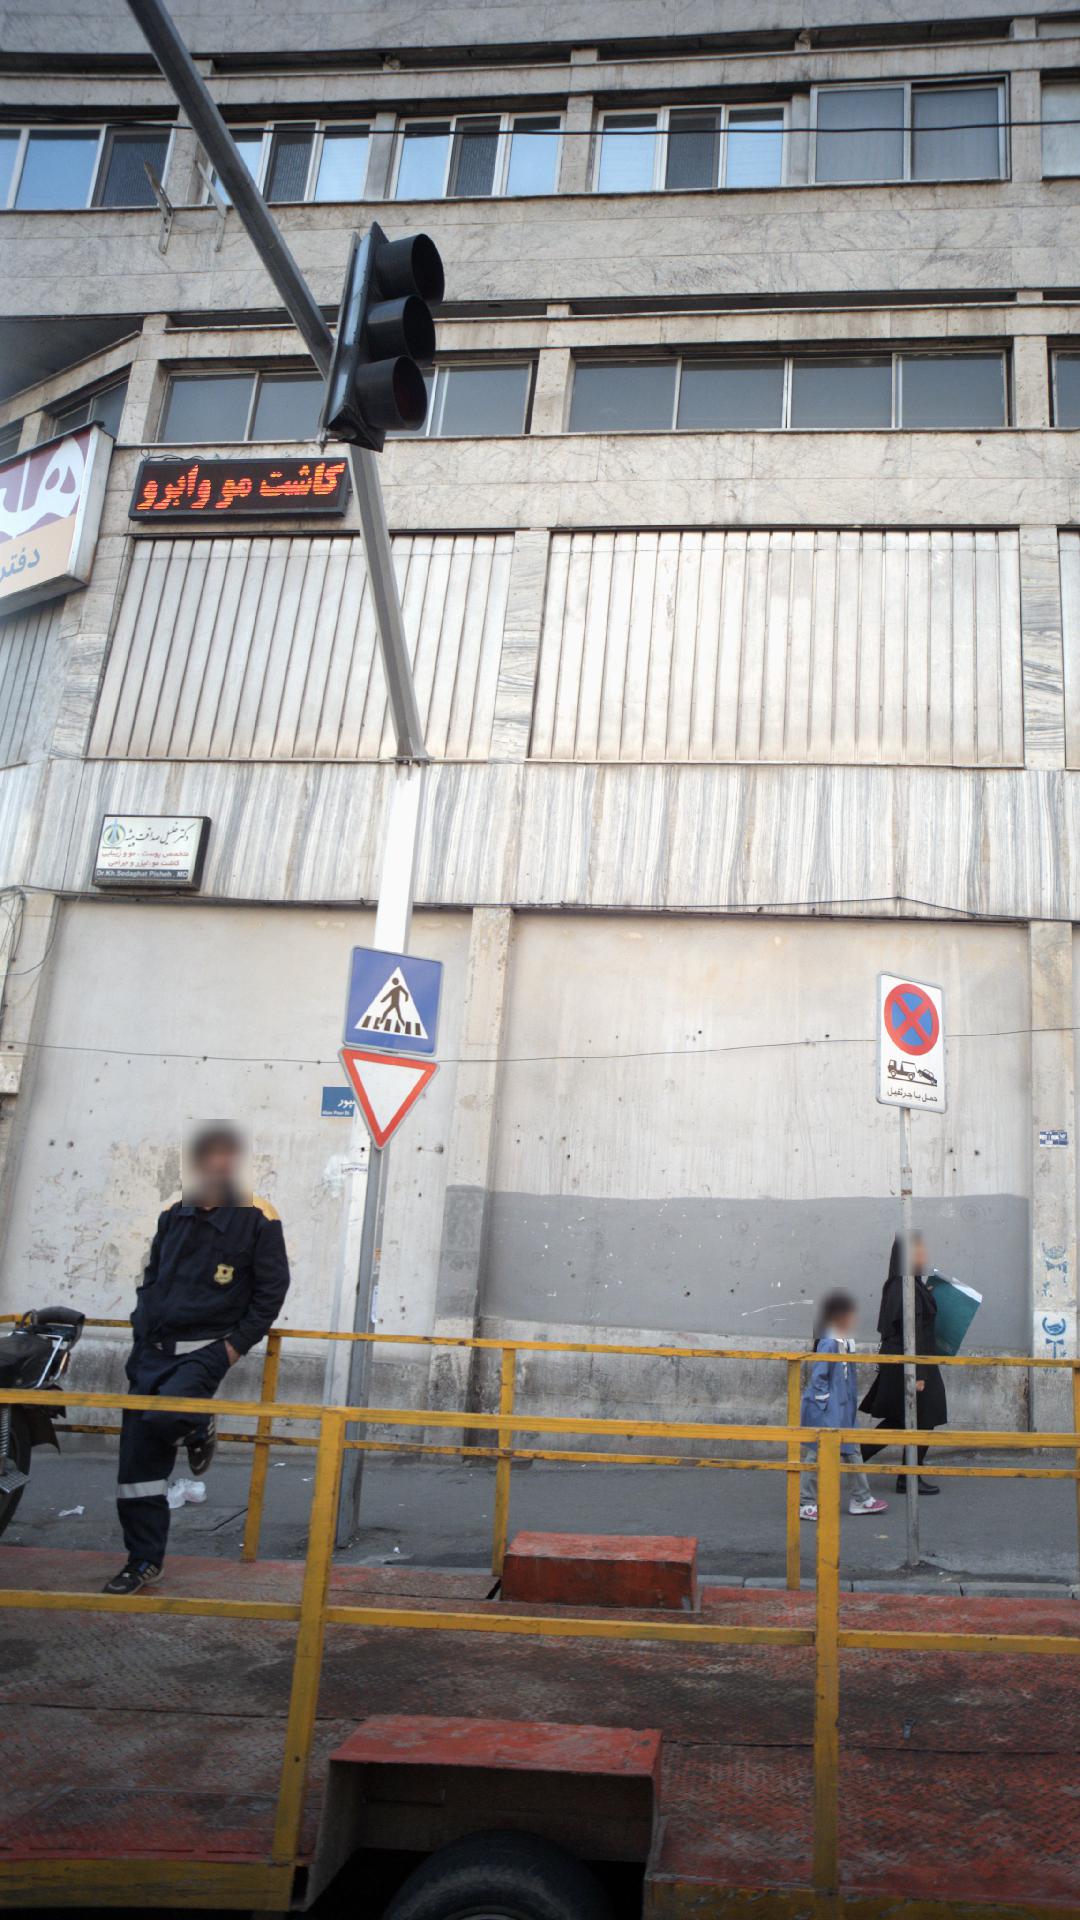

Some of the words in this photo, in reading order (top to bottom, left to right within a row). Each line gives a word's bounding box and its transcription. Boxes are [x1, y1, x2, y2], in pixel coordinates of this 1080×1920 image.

[260, 463, 346, 496] کاشت
[215, 478, 252, 509] مو
[887, 1087, 913, 1099] جرثقیل
[914, 1091, 921, 1100] با
[922, 1093, 938, 1103] حمل
